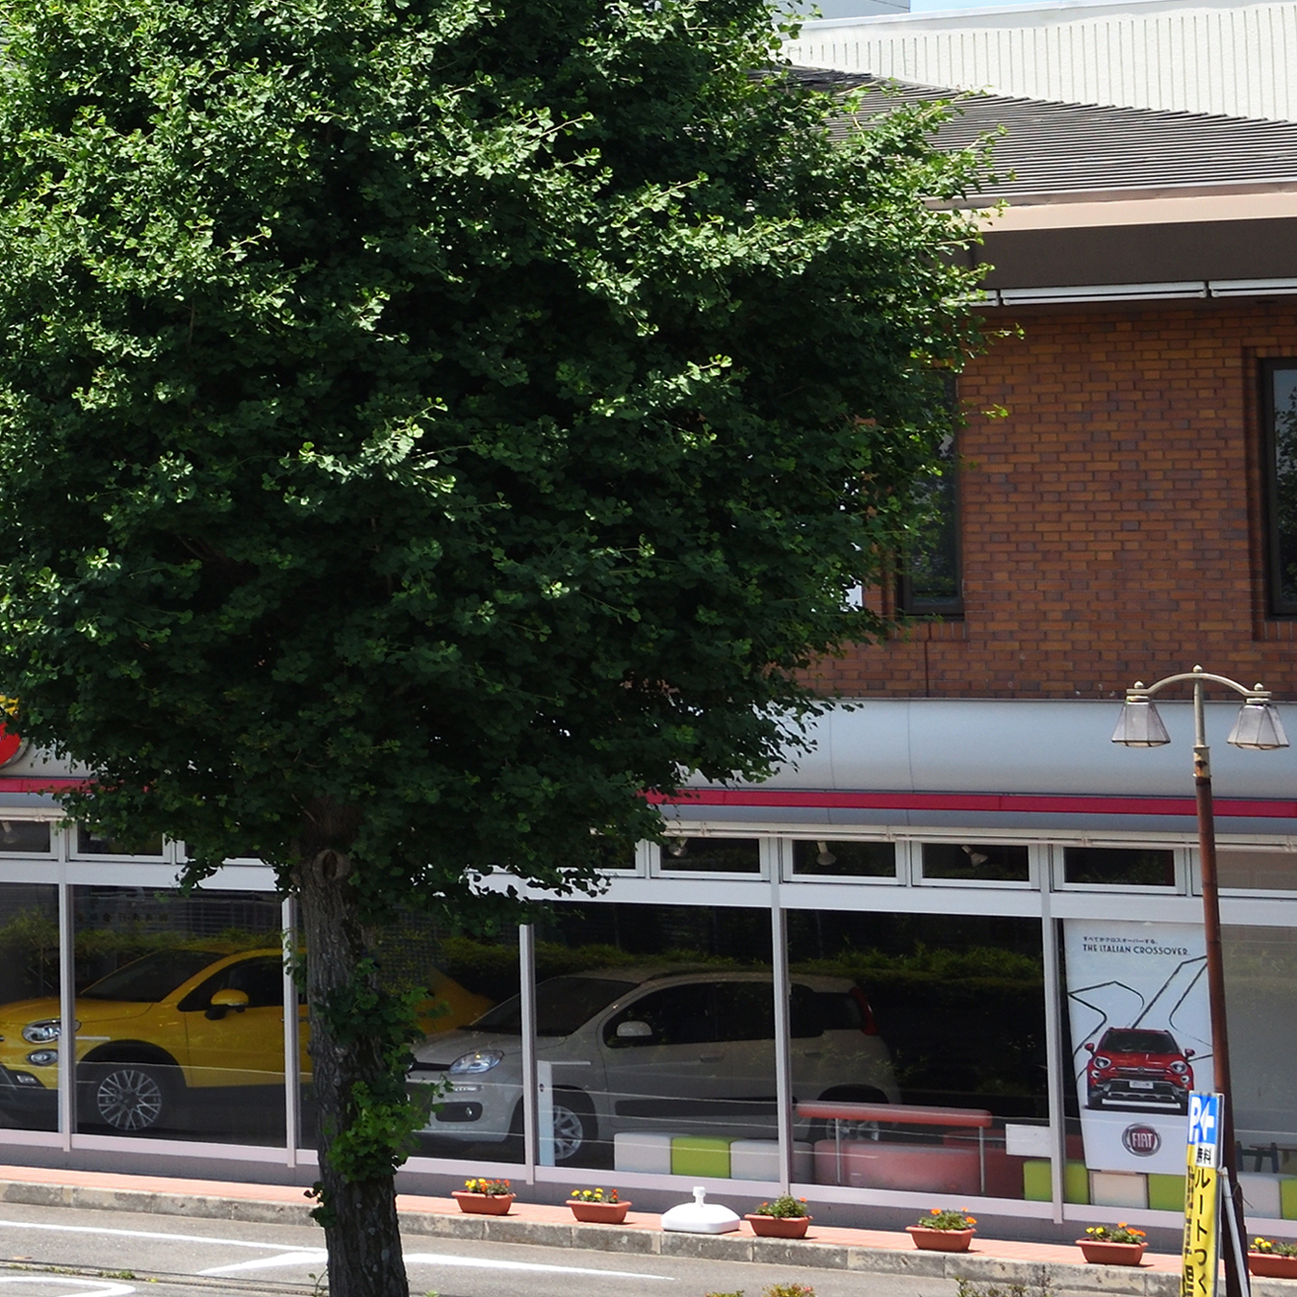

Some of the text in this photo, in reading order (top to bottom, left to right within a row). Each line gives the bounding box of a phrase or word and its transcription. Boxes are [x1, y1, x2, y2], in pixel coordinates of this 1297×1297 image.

[1083, 944, 1097, 953] THE
[1188, 1096, 1202, 1142] P
[1132, 1132, 1154, 1148] FIAT
